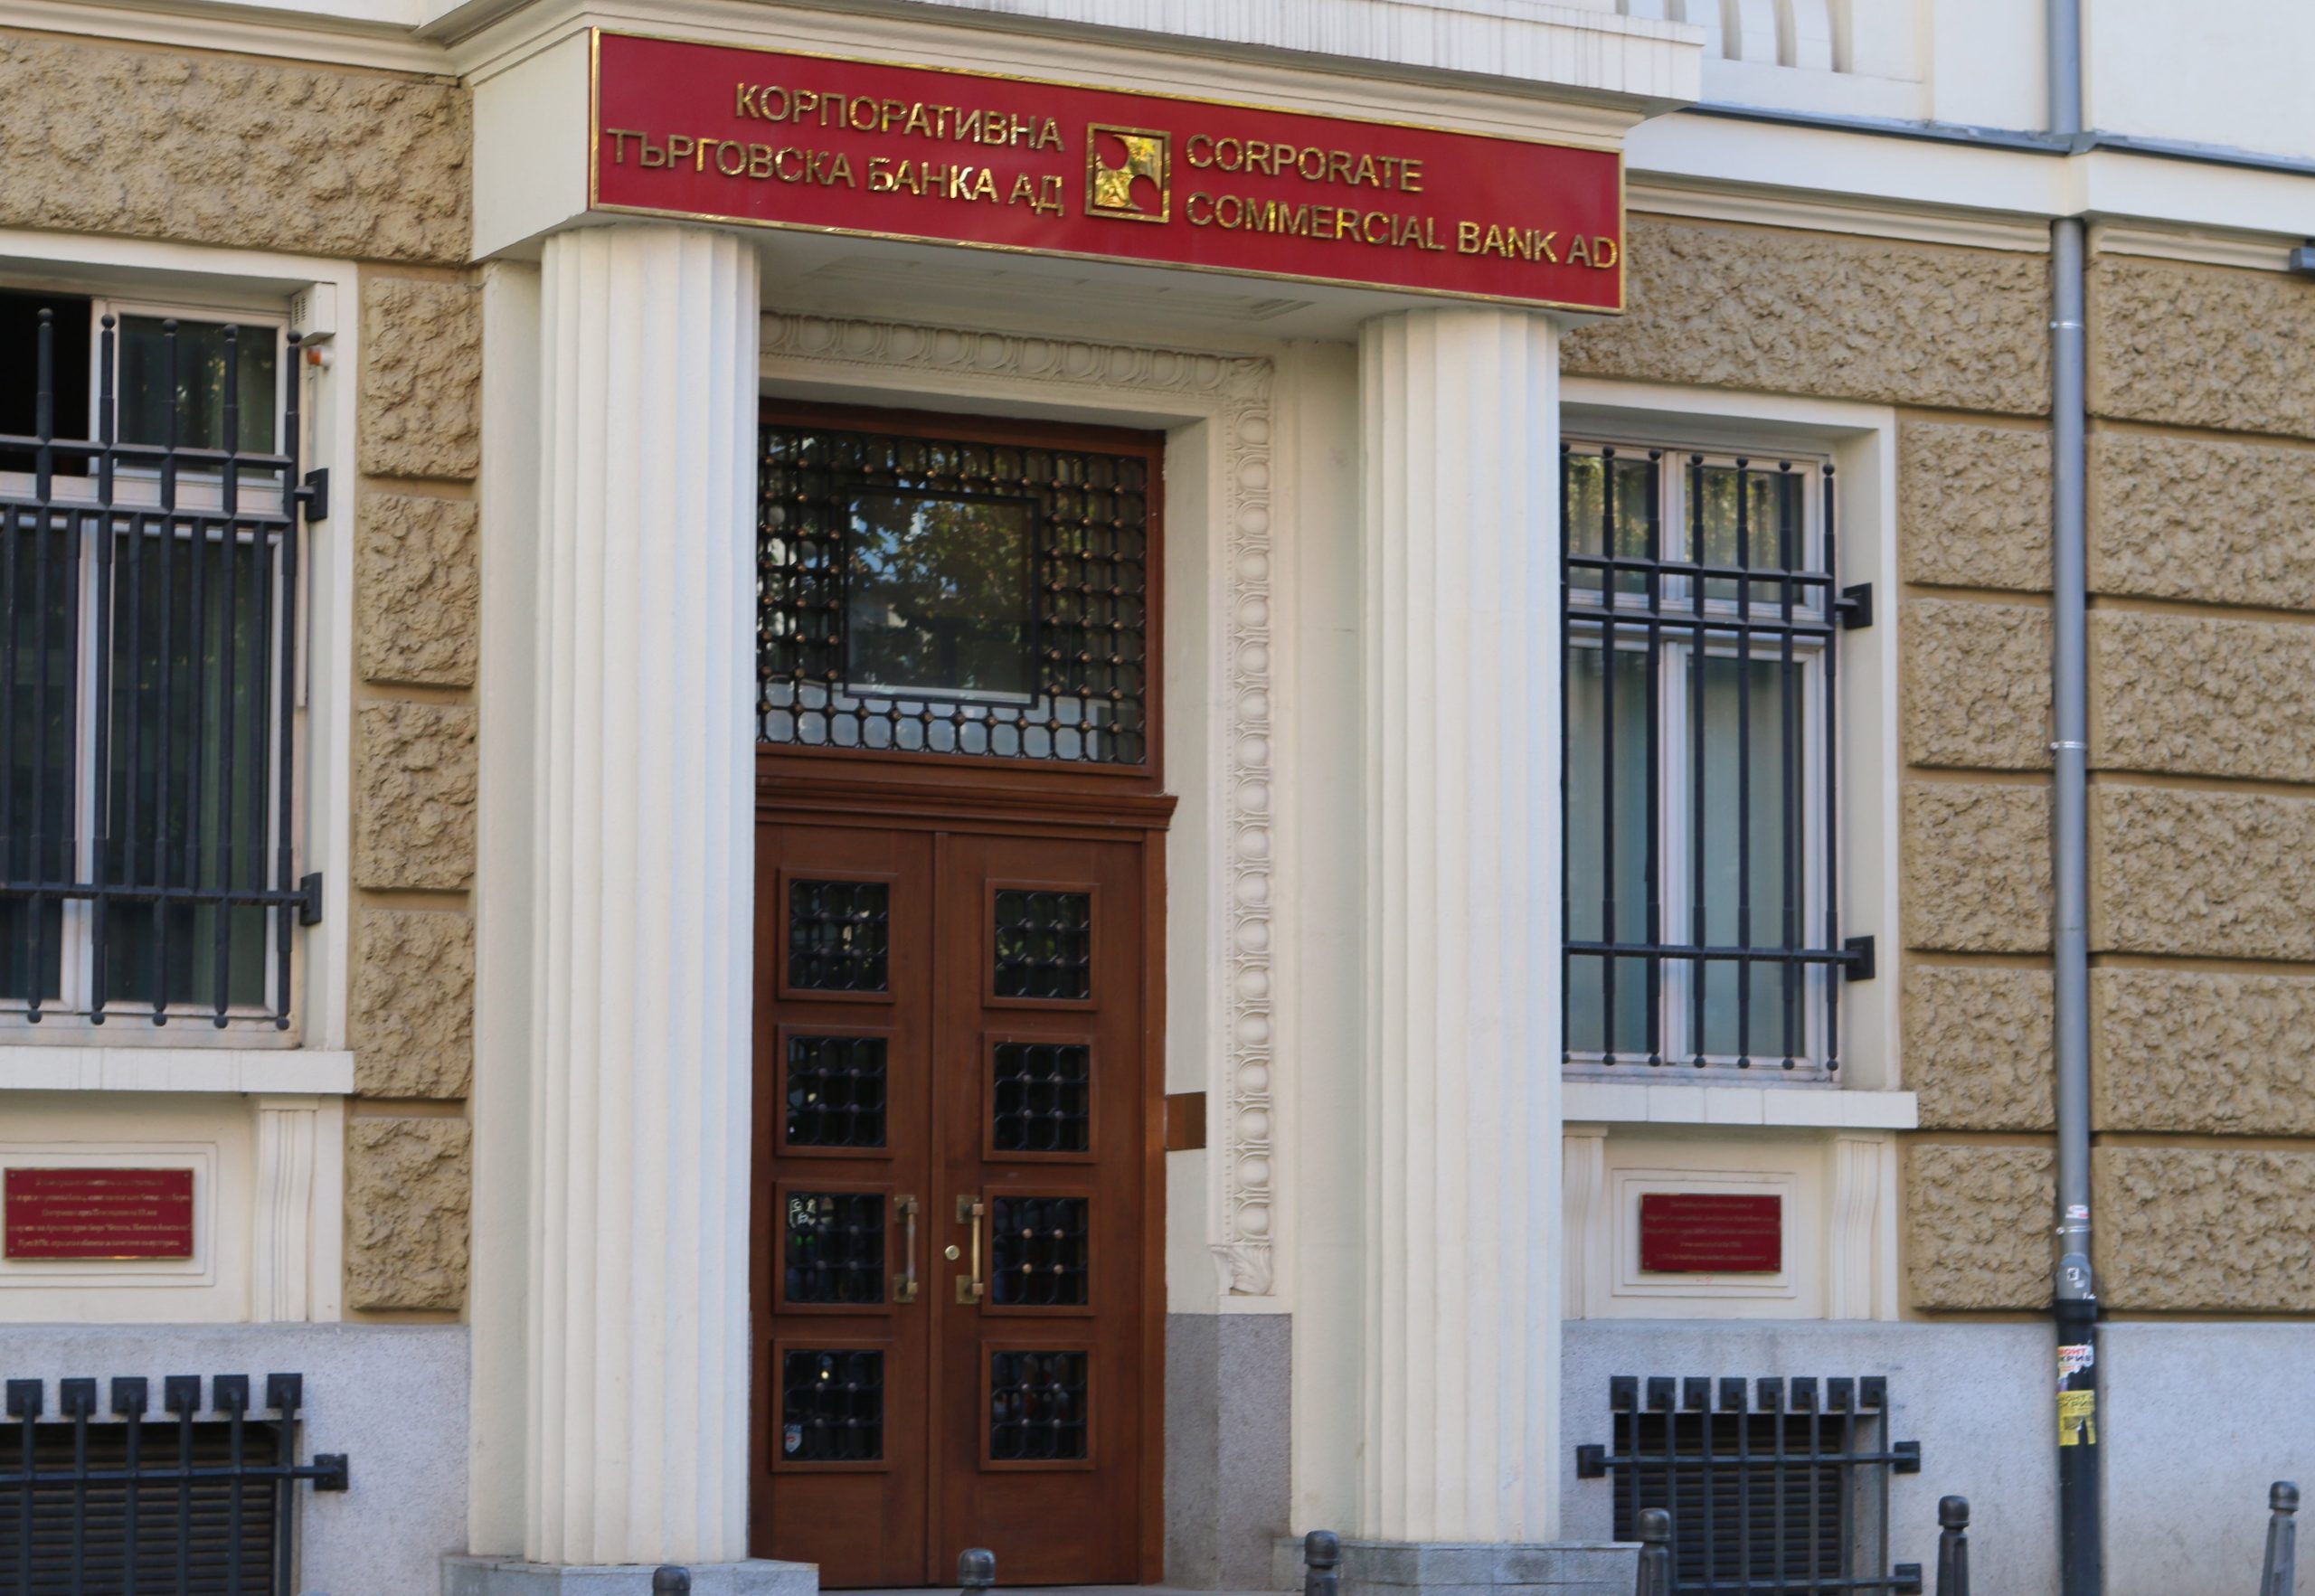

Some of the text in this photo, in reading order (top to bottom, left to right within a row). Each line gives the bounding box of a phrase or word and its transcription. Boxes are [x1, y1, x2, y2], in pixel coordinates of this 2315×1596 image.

[735, 82, 1064, 151] КОРПОРАТИВНА
[607, 128, 1064, 216] ТЪРГОВСКА БАНКА АД
[1186, 134, 1423, 193] CORPORATE
[1186, 192, 1619, 269] COMMERCIAL BANK AD
